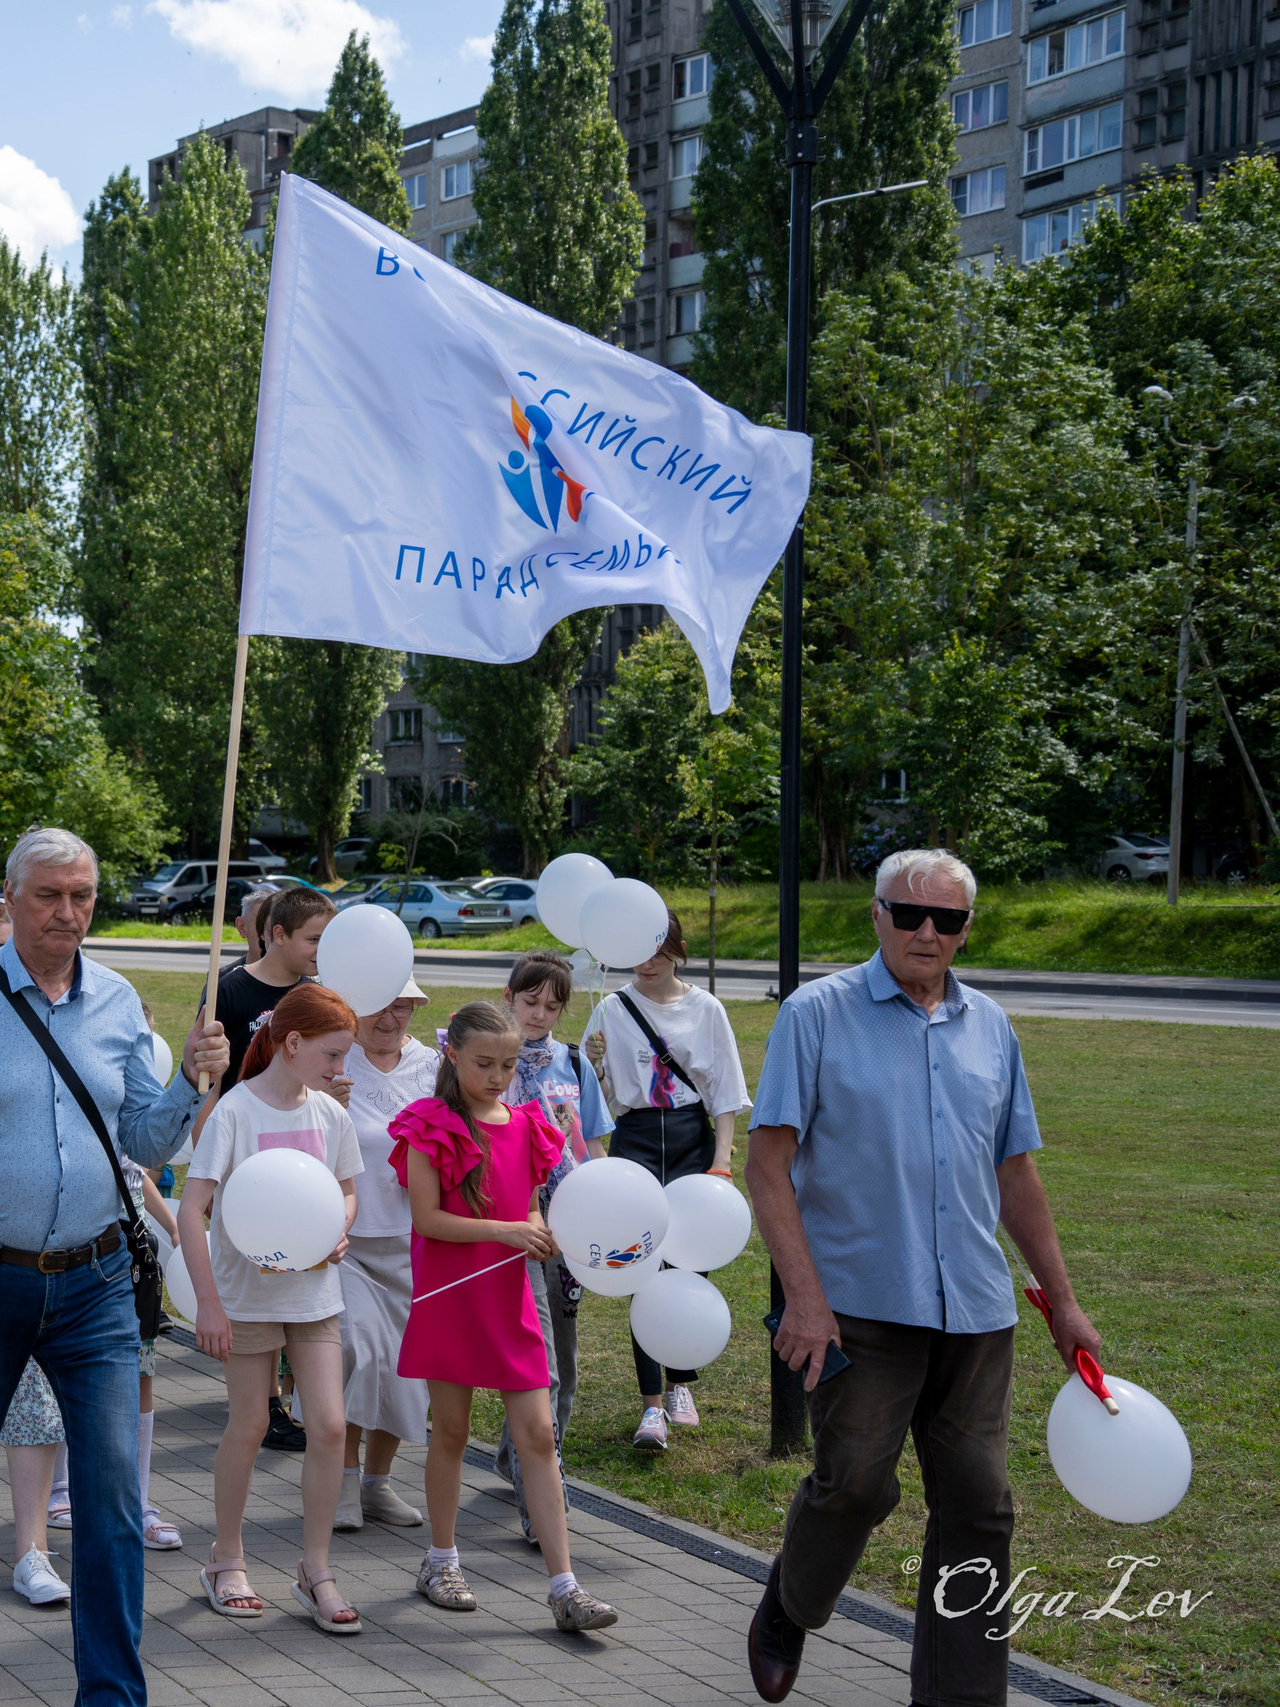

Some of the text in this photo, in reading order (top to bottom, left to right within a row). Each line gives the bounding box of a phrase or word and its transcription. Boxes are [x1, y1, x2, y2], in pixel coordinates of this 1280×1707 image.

[395, 544, 540, 599] ПАРАД
[543, 1080, 580, 1098] Love
[247, 1251, 287, 1263] АРАД
